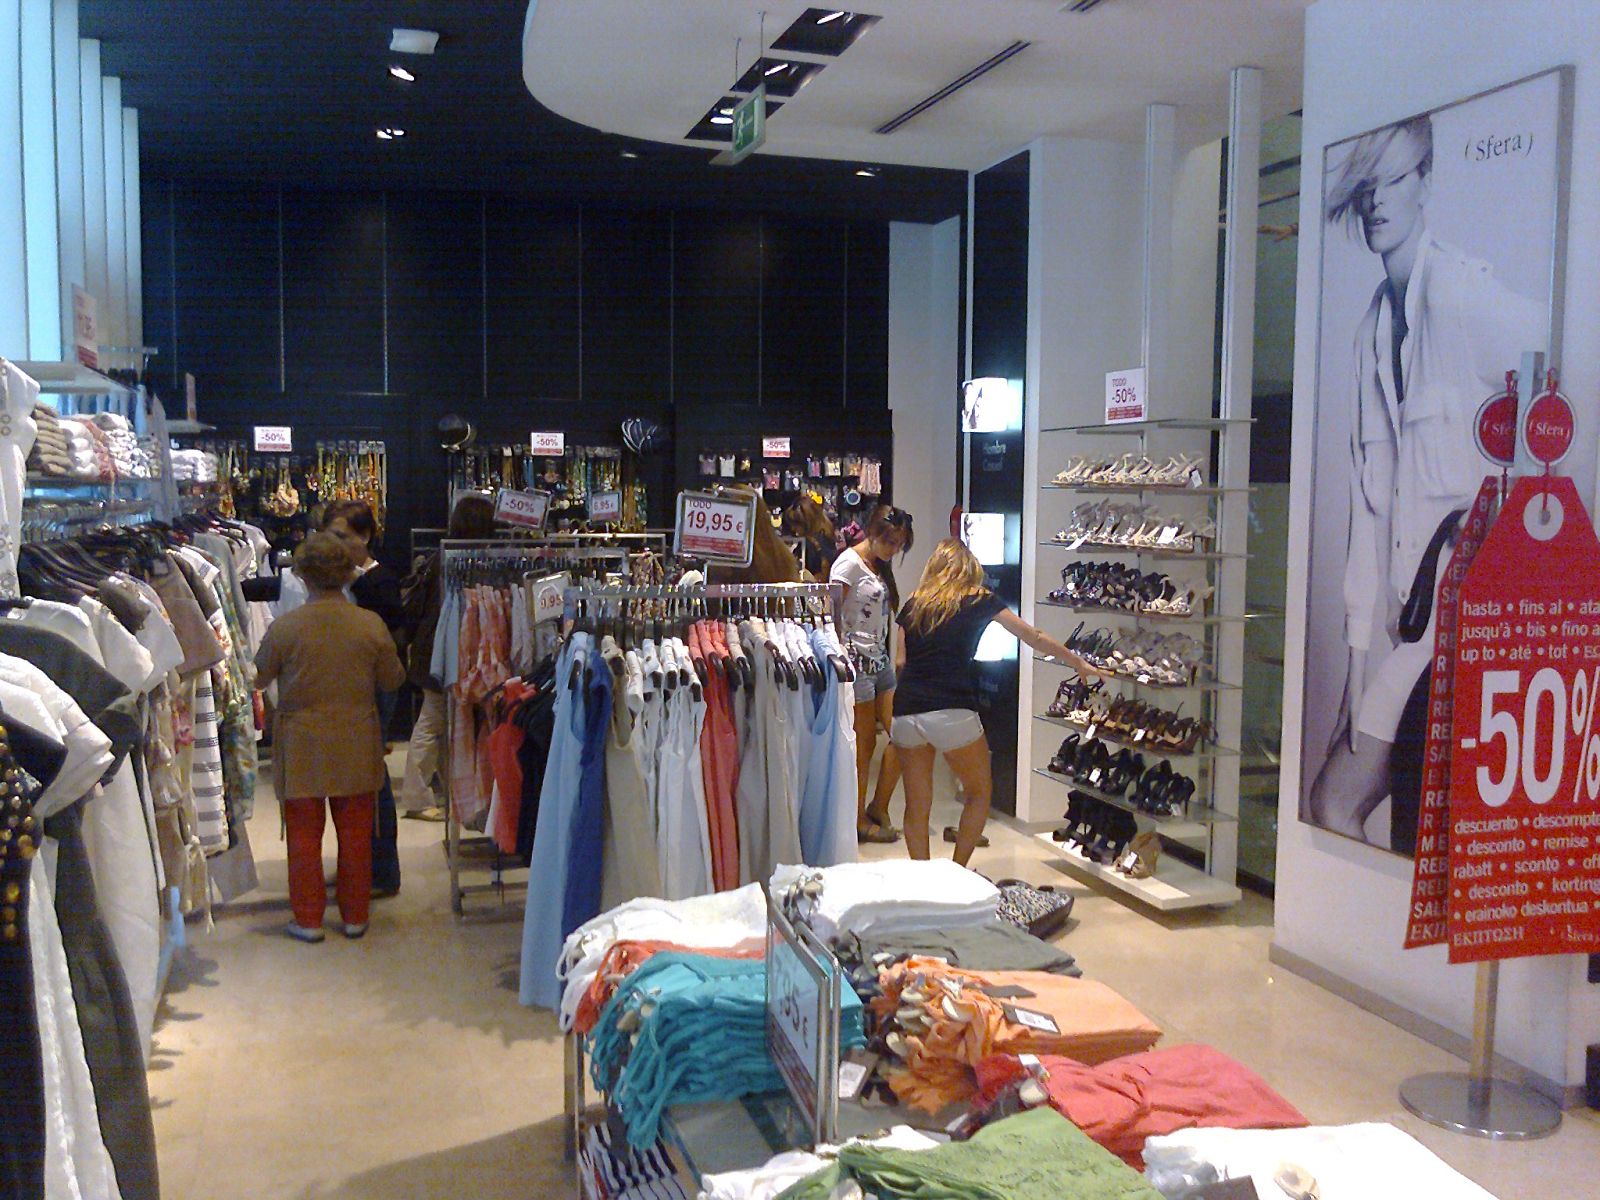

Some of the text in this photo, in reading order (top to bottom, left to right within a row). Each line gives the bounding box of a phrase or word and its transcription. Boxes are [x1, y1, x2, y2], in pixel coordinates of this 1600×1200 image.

[1112, 387, 1136, 404] -50%
[261, 433, 285, 441] -50%
[537, 438, 559, 447] -50%
[505, 498, 534, 513] -50%
[687, 510, 744, 533] 19,95 €
[1462, 600, 1500, 617] hasta
[1519, 599, 1544, 615] fins
[1549, 599, 1562, 615] al
[1461, 622, 1511, 642] jusqu'à
[1526, 622, 1547, 637] bis
[1561, 620, 1588, 637] fino
[1461, 648, 1478, 664] up
[1482, 645, 1496, 661] to
[1509, 644, 1532, 660] até
[1548, 643, 1567, 659] tot
[1461, 666, 1600, 808] -50%
[1454, 815, 1519, 834] descuento
[1467, 838, 1526, 856] desconto
[1543, 833, 1589, 850] remise
[1453, 860, 1492, 879] rabatt
[1514, 856, 1560, 873] sconto
[1468, 880, 1529, 899] desconto
[1551, 876, 1600, 895] korting
[1520, 898, 1589, 918] deskontua
